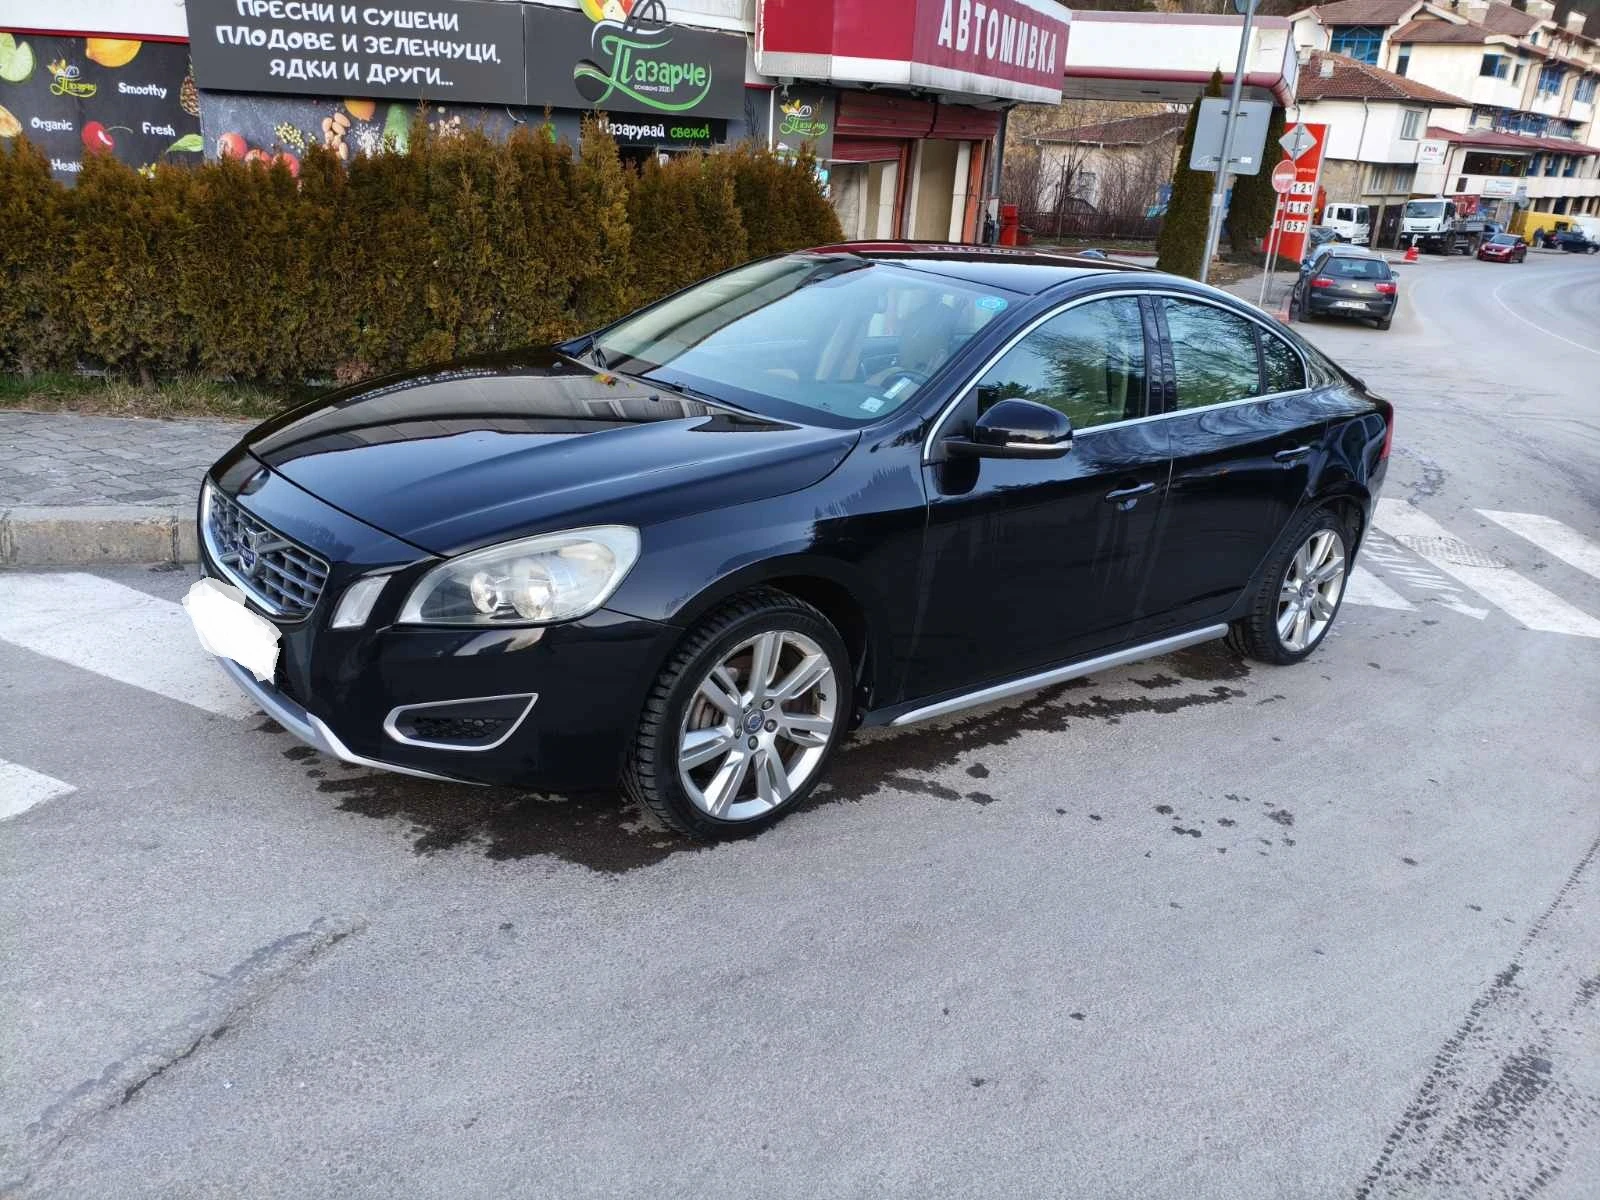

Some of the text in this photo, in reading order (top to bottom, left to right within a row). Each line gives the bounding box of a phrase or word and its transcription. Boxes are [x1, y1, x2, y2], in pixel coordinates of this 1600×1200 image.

[236, 0, 459, 31] ПРЕСНИ И СУШЕНИ
[215, 25, 501, 64] ПЛОДОВЕ И ЗЕЛЕНЧУЦИ,
[938, 0, 1056, 74] АВТОМИВКА
[269, 58, 454, 86] ЯДКИ И ДРУГИ...
[580, 35, 709, 105] Пазарче
[118, 82, 167, 99] Smoothy
[32, 117, 73, 131] Organic
[142, 122, 175, 136] Fresh
[670, 123, 710, 138] свежо!
